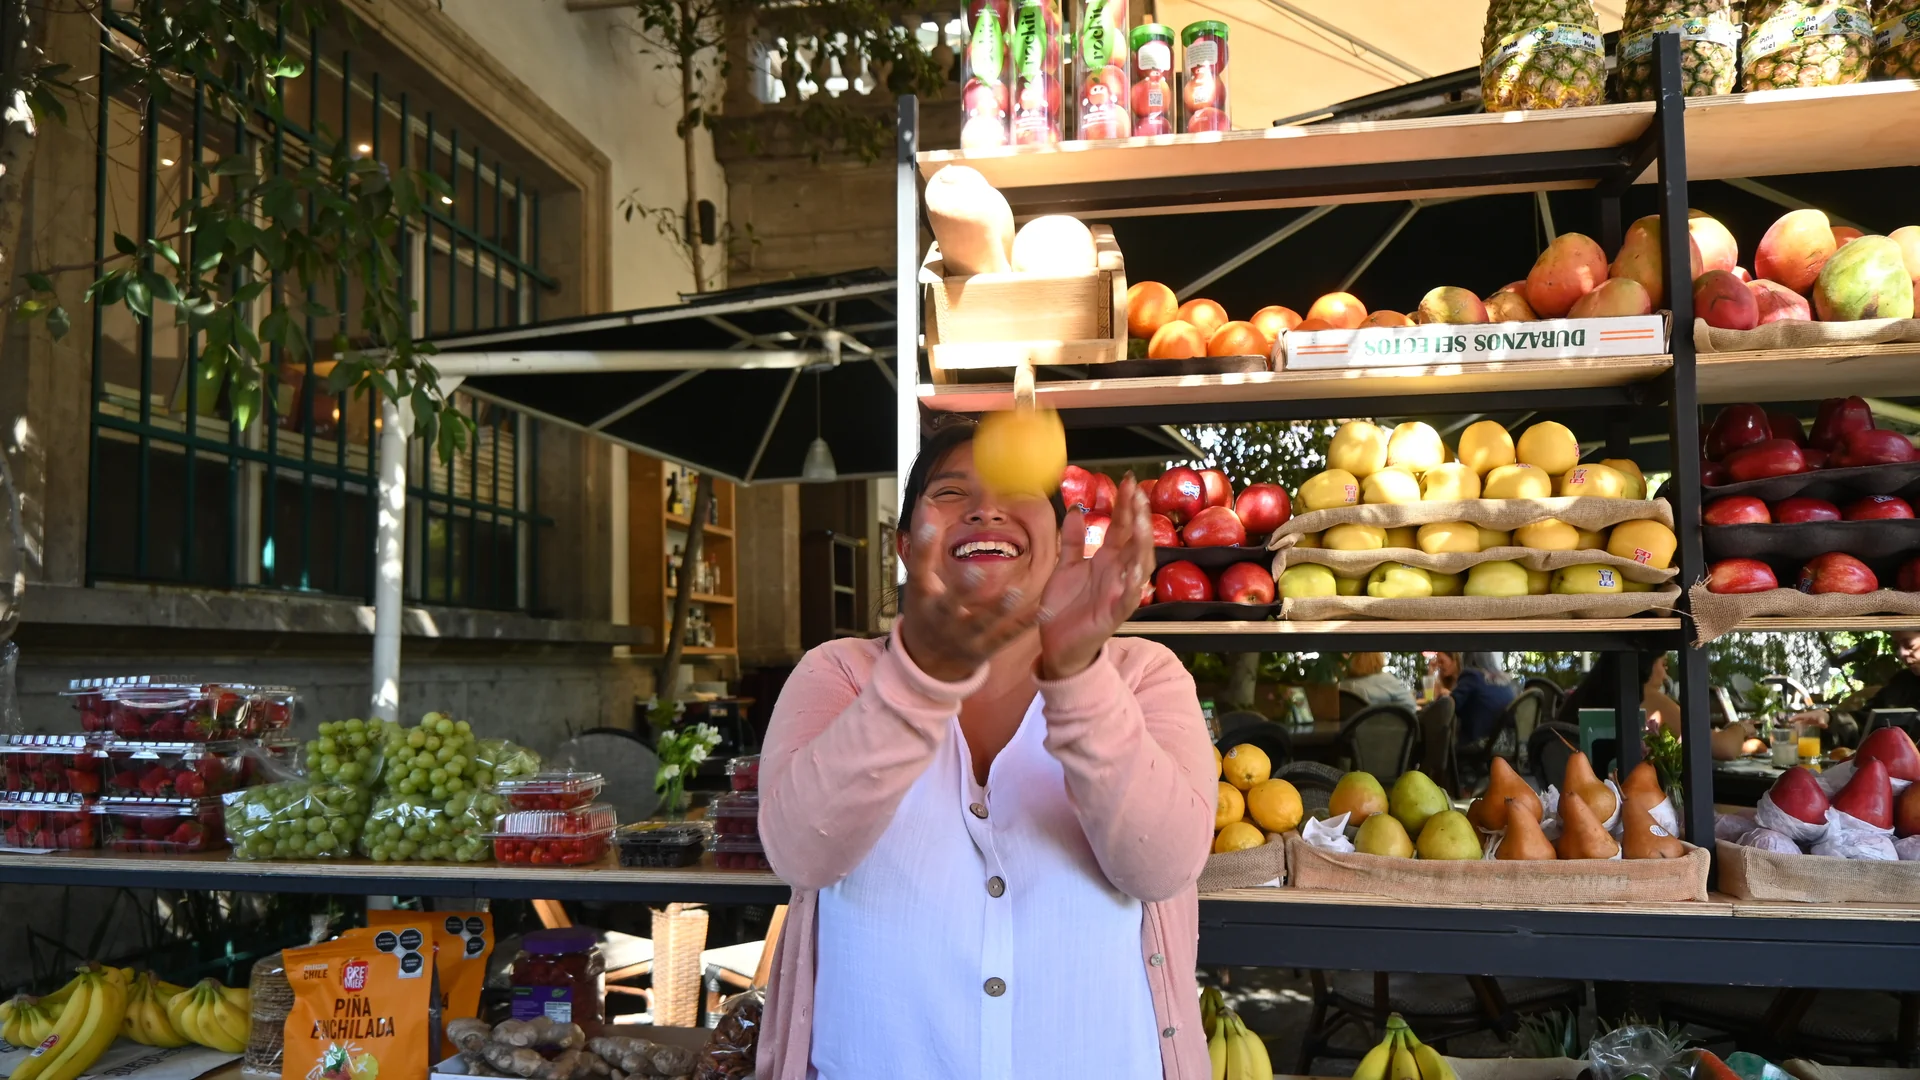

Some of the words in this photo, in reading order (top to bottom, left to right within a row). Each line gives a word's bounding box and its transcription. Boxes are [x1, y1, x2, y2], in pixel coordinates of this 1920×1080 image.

[1021, 12, 1035, 65] rockit
[1364, 335, 1467, 357] SELECTOS
[1475, 329, 1586, 352] DURAZNOS
[303, 968, 328, 980] CHILE
[346, 966, 366, 979] PRE
[334, 995, 371, 1018] PIÑA
[310, 1017, 395, 1040] ENCHILADA
